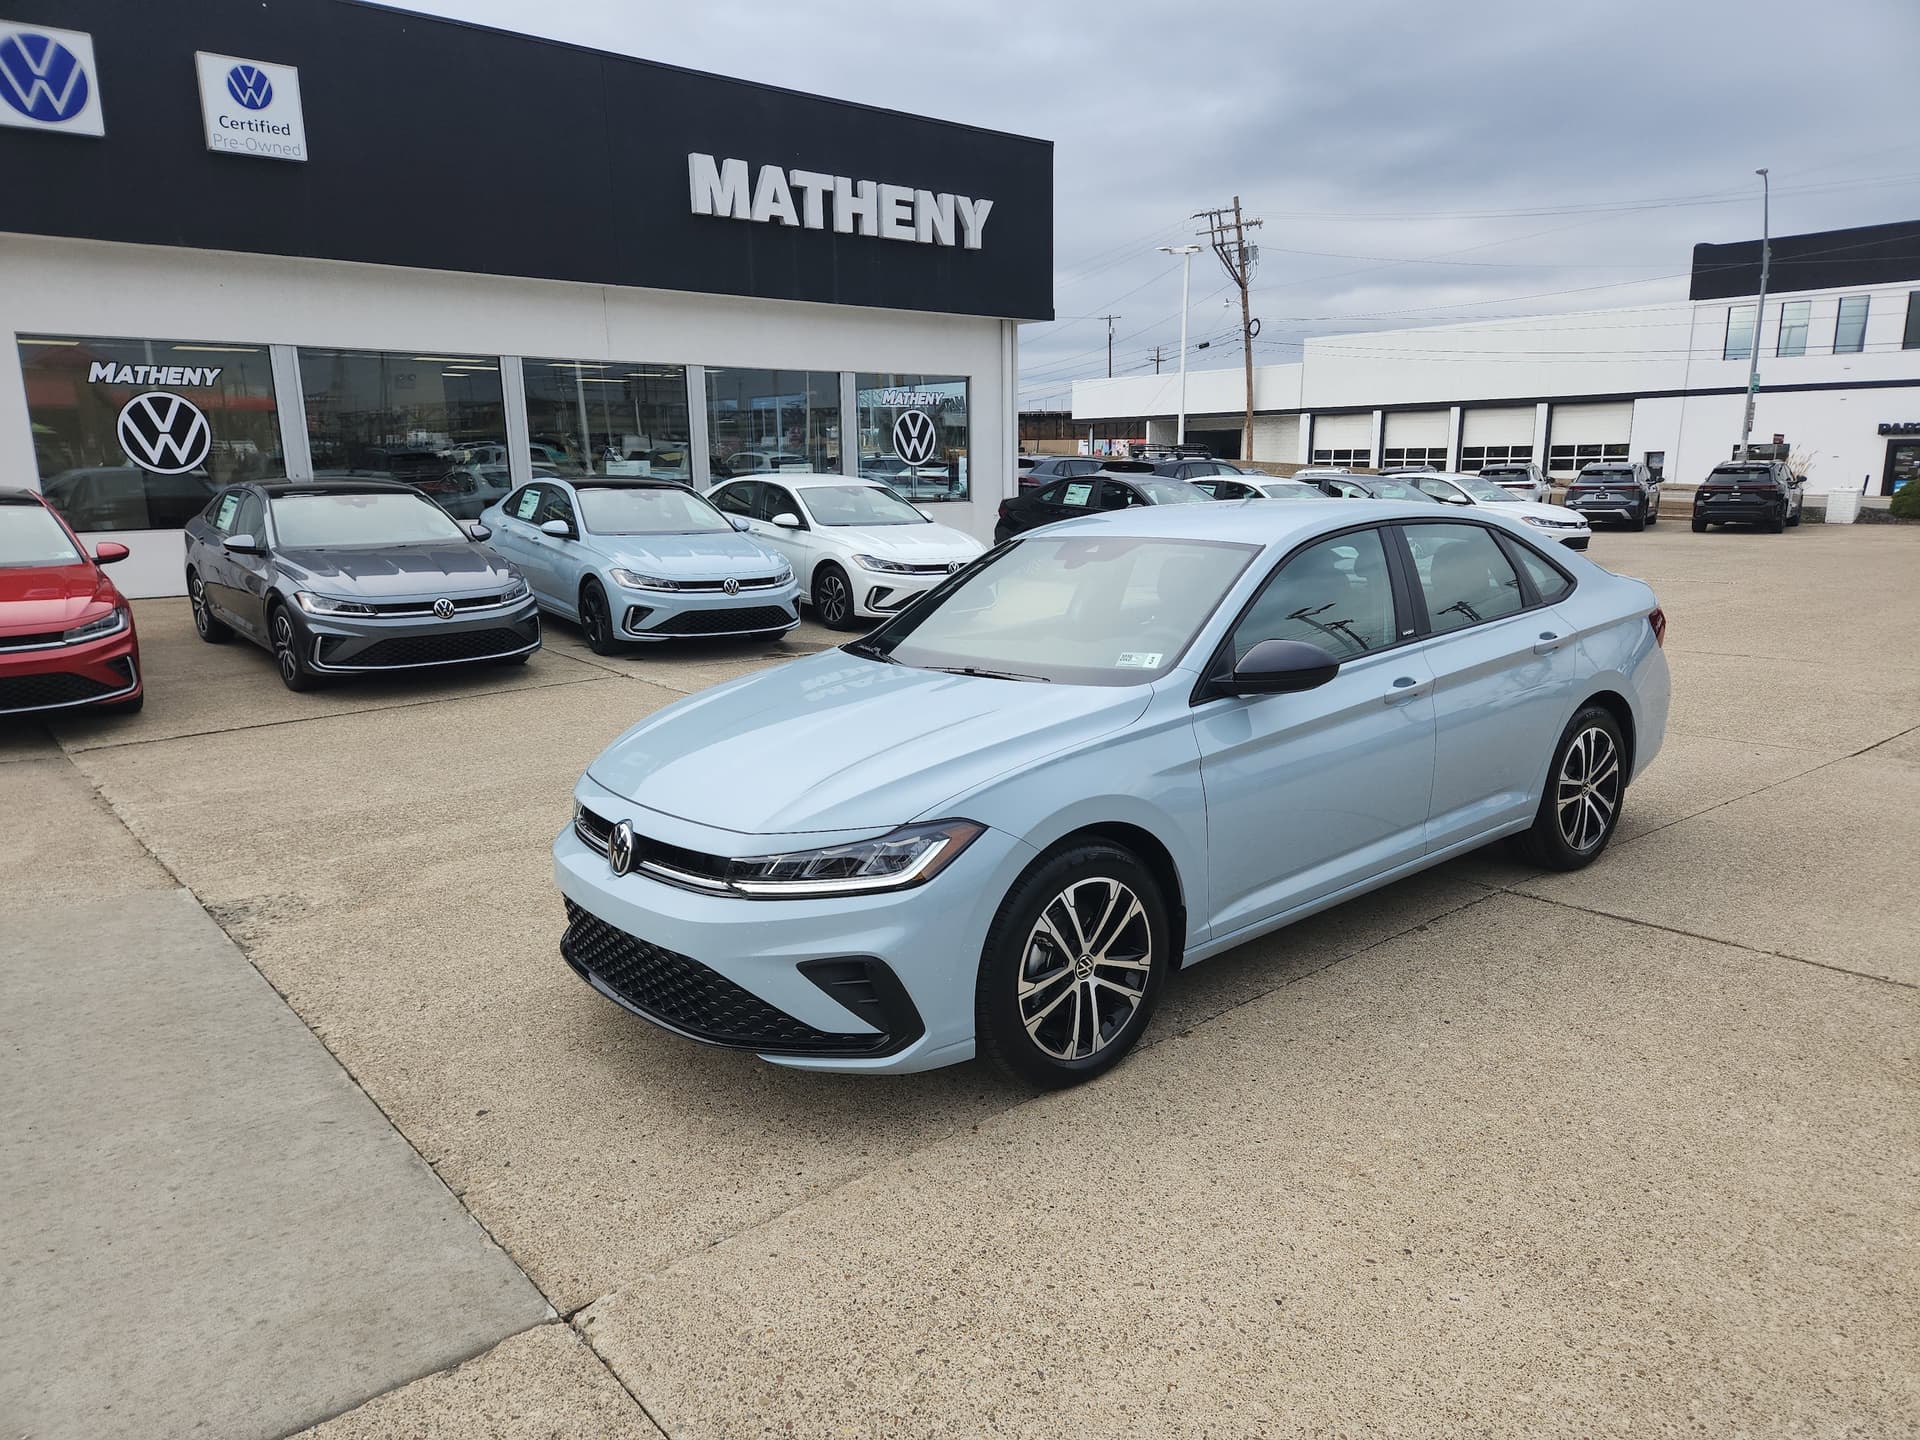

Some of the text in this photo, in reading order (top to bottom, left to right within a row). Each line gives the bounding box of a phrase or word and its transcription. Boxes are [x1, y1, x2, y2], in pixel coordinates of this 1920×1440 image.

[219, 115, 291, 136] Certified
[213, 132, 302, 157] Pre-Owned
[688, 152, 994, 250] MATHENY
[88, 361, 222, 387] MATHENY
[882, 390, 944, 406] MATHENY
